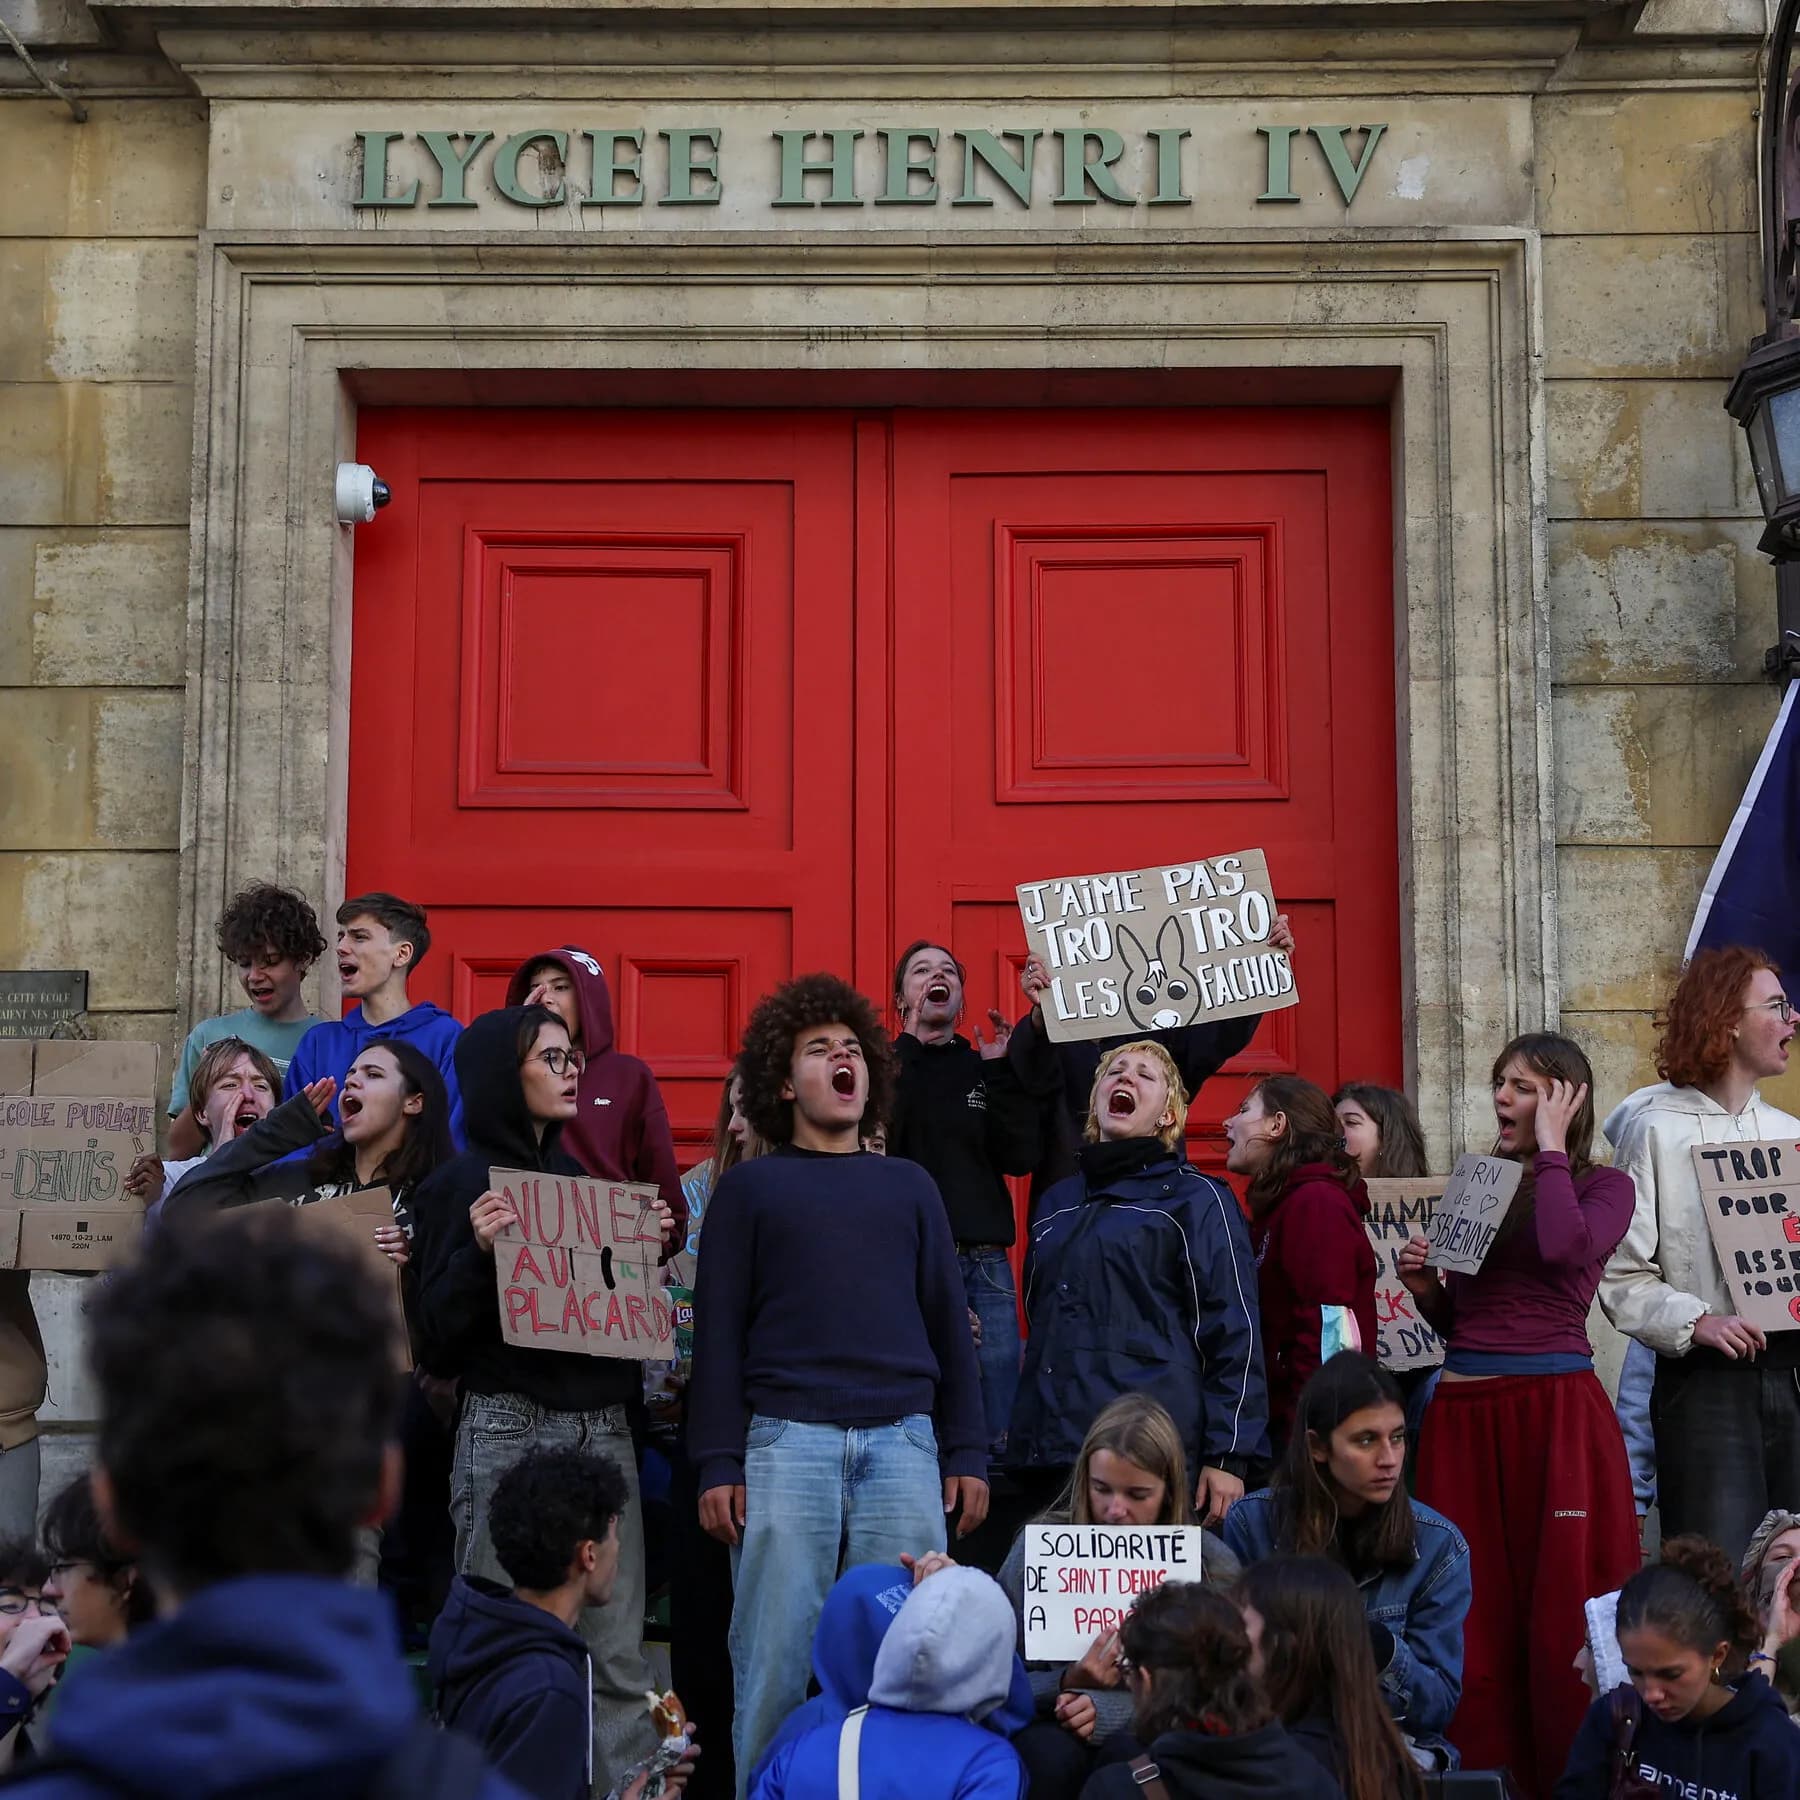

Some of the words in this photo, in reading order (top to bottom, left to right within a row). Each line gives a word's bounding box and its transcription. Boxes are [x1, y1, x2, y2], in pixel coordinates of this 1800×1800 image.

[353, 128, 722, 209] LYCEE
[770, 127, 1192, 208] HENRI
[1256, 123, 1389, 207] IV
[1161, 857, 1245, 904] PAS
[1038, 917, 1113, 969] TRO
[1181, 890, 1271, 953] TRO
[8, 992, 36, 1003] CETTE
[1051, 976, 1121, 1021] LES
[1197, 952, 1293, 1009] FACHOS
[1470, 1161, 1503, 1185] RN
[1701, 1146, 1781, 1182] TROP
[502, 1180, 661, 1249] NUNEZ
[1454, 1188, 1471, 1206] de
[1718, 1192, 1789, 1217] POUR
[512, 1246, 569, 1289] AU
[504, 1284, 672, 1342] PLACARD
[1026, 1566, 1048, 1593] DE
[1058, 1567, 1111, 1594] SAINT
[1029, 1605, 1046, 1631] A
